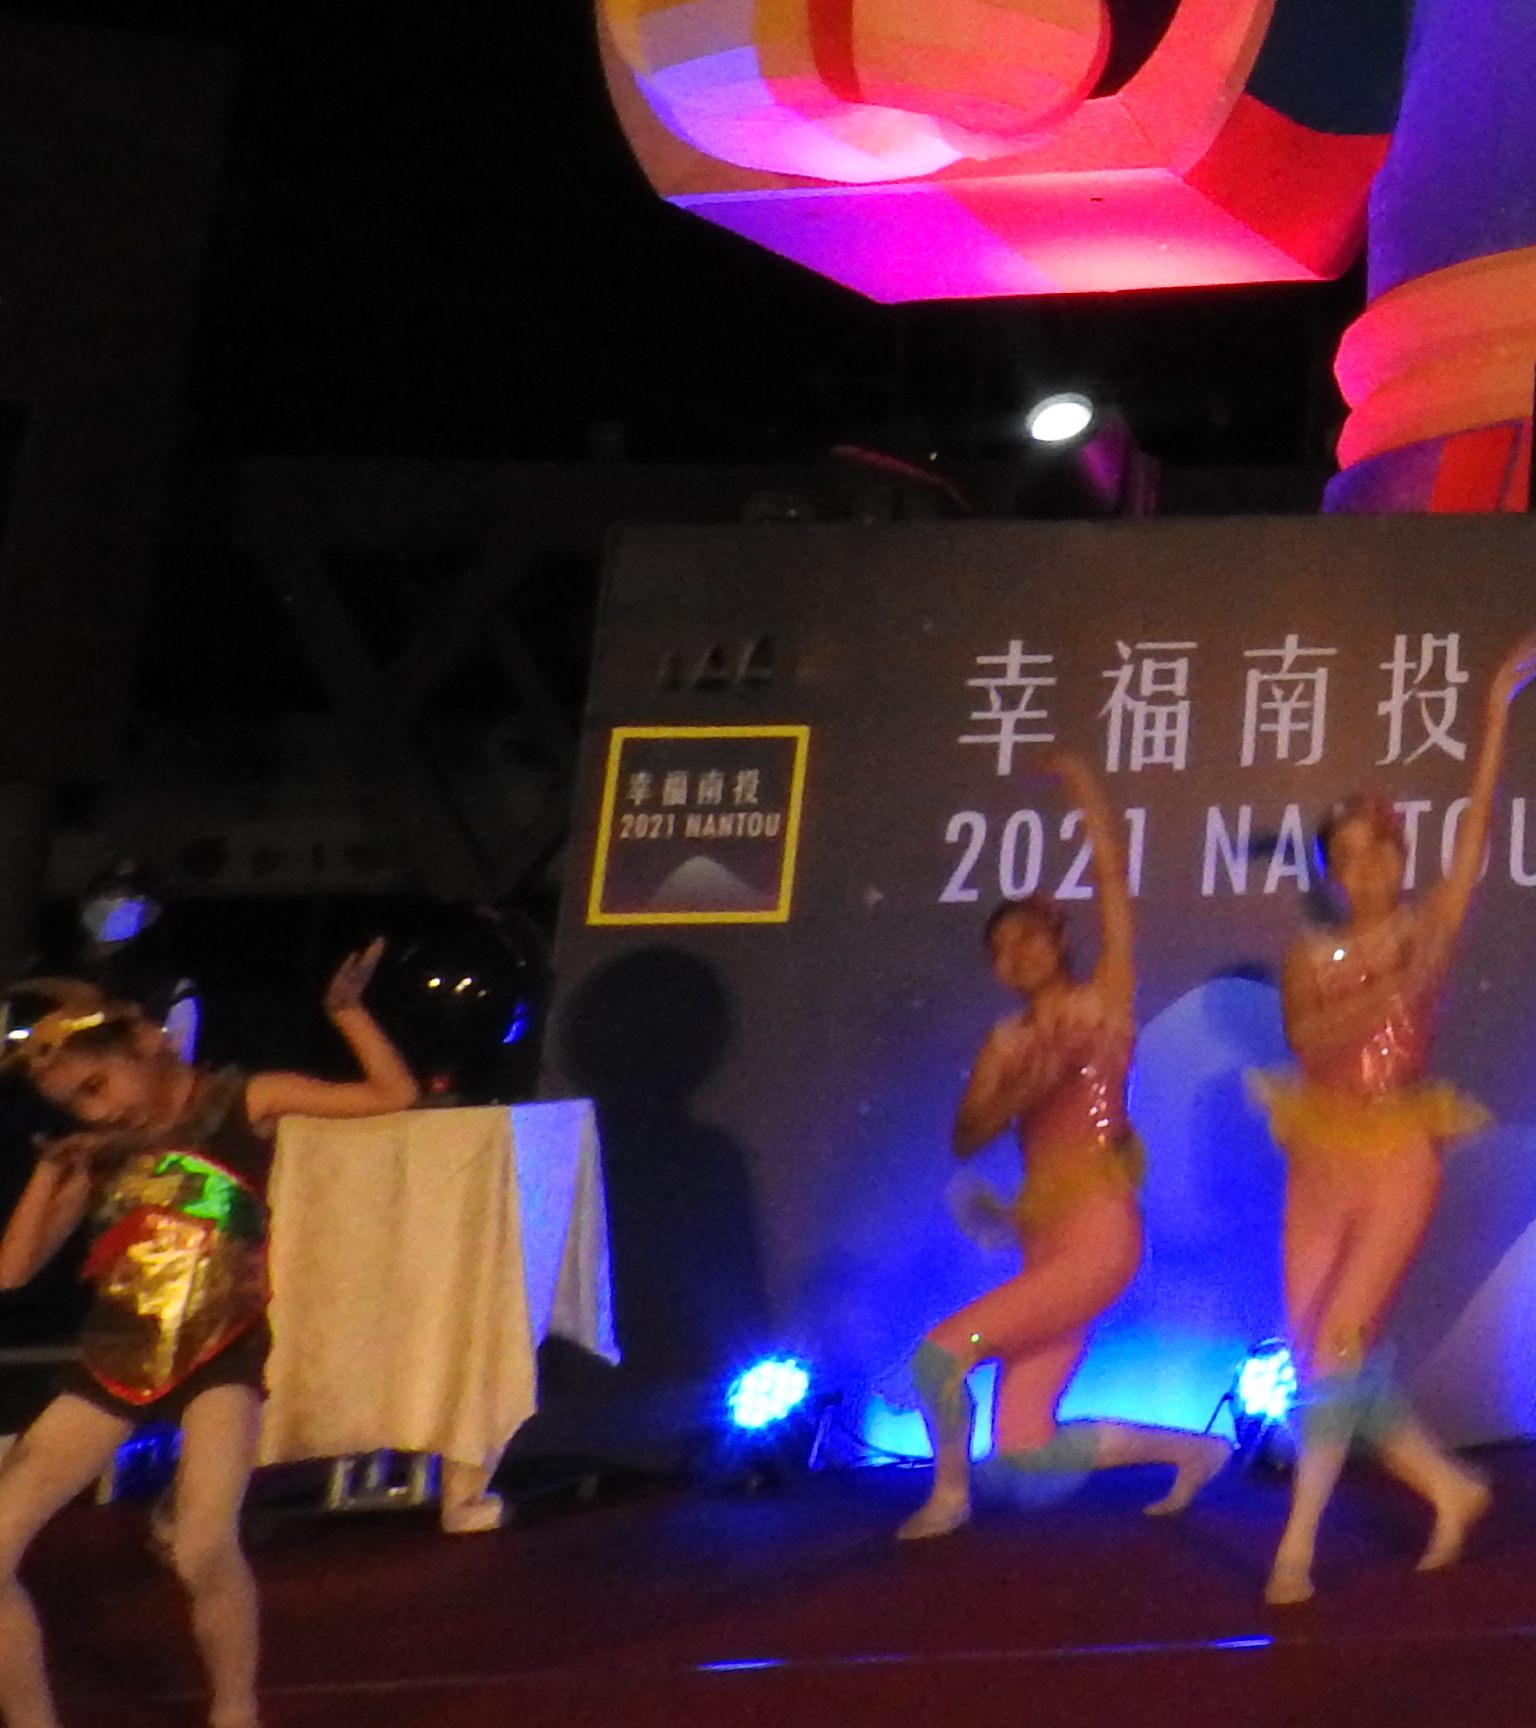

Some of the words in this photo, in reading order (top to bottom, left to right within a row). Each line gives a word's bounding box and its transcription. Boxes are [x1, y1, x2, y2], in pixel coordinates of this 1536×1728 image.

[957, 633, 1469, 776] 幸福南投
[619, 813, 675, 839] 2021
[685, 812, 781, 839] NANTOU
[938, 806, 1147, 902] 2021
